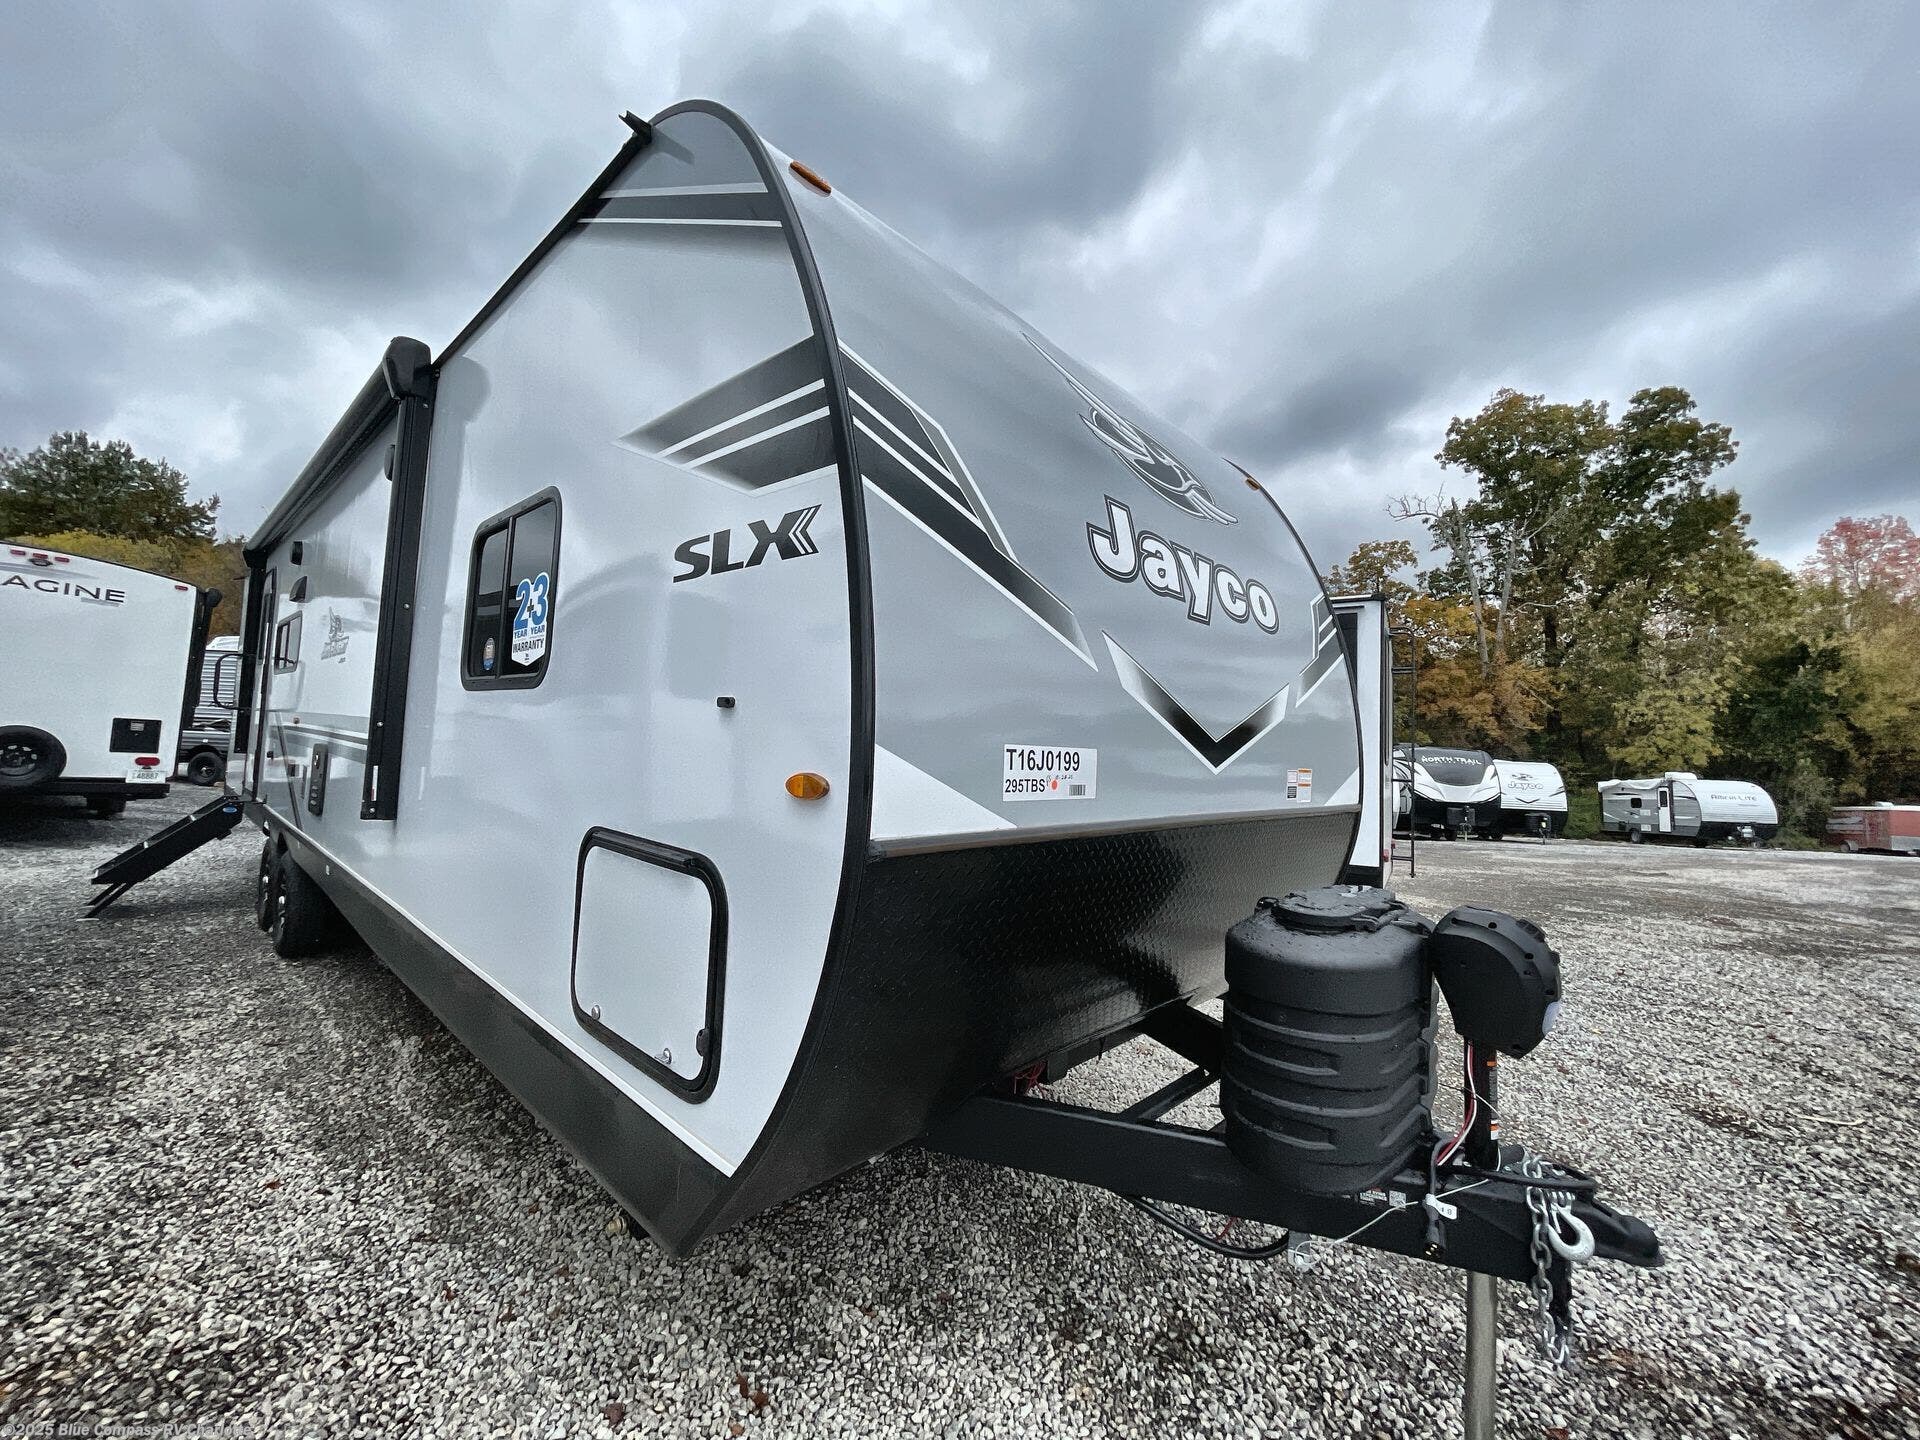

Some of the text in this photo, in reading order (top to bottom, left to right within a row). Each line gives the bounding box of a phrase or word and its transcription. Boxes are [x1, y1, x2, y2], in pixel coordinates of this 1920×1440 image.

[673, 504, 822, 583] SLX
[1086, 494, 1280, 635] Jayco
[514, 624, 545, 639] YEAR YEAR
[512, 638, 544, 653] WARRANTY
[1006, 749, 1080, 771] T16J0199
[1005, 779, 1045, 793] 295TBS
[1508, 781, 1544, 791] Jayco
